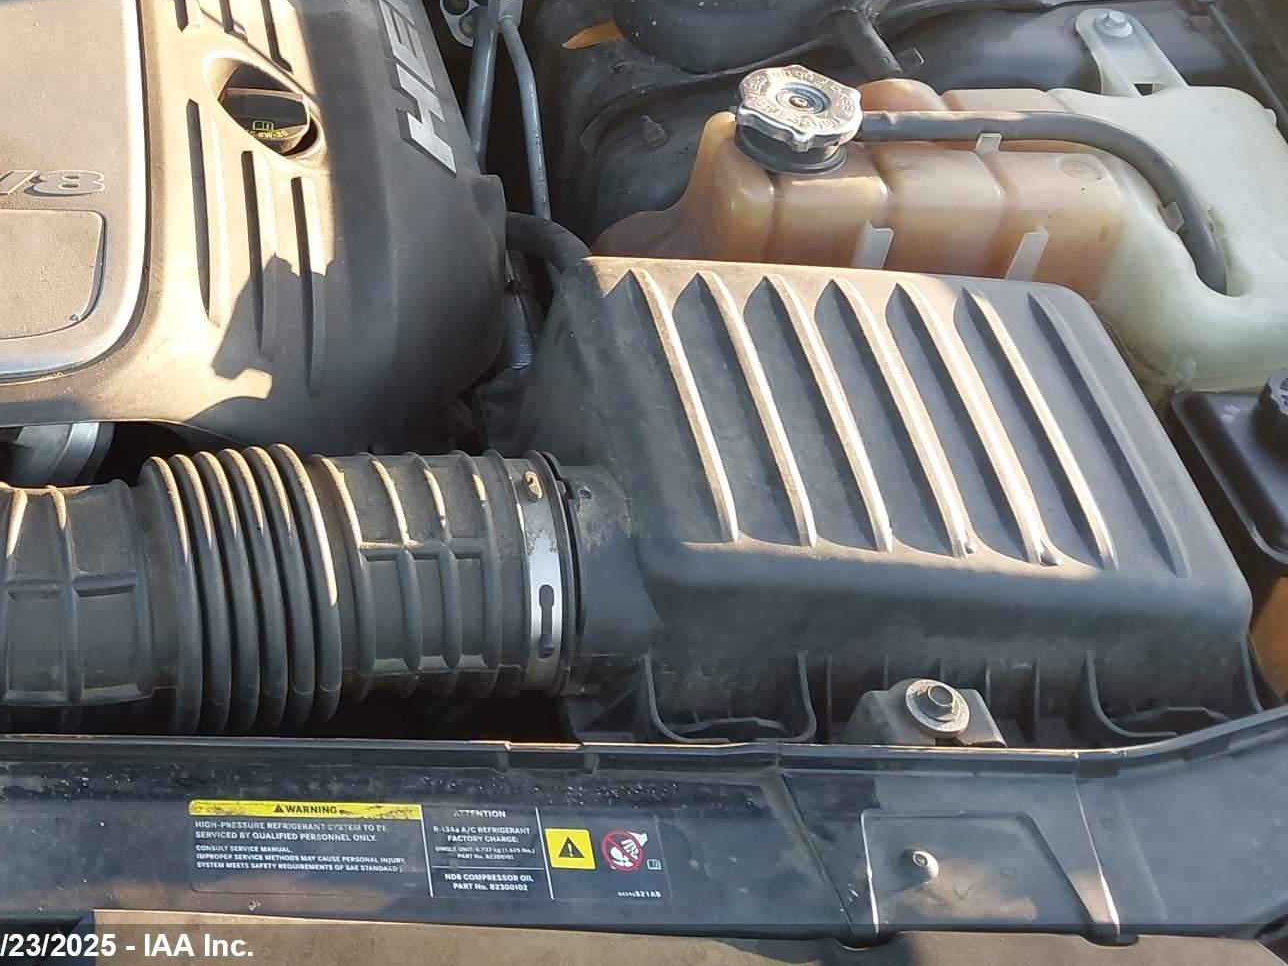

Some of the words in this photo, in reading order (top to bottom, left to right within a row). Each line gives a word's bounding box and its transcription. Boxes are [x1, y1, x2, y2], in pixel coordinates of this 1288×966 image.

[285, 805, 338, 814] WARNING
[453, 809, 506, 818] ATTENTION
[195, 821, 266, 830] HIGH-PRESSURE
[266, 822, 326, 831] REFRIGERANT
[364, 824, 374, 832] TO
[433, 826, 460, 834] R-134a
[461, 826, 477, 834] A/C
[478, 826, 530, 835] REFRIGERANT
[195, 831, 238, 839] SERVICED
[239, 832, 251, 840] BY
[252, 832, 298, 840] QUALIFIED
[300, 833, 351, 841] PERSONNEL
[353, 834, 378, 842] ONLY.
[196, 845, 228, 853] CONSULT
[230, 845, 258, 853] SERVICE
[234, 854, 264, 862] SERVICE
[265, 854, 300, 862] METHODS
[318, 855, 340, 863] CAUSE
[196, 861, 224, 869] SYSTEM
[250, 862, 277, 870] SAFETY
[278, 863, 334, 871] REQUIREMENTS
[463, 874, 518, 882] COMPRESSOR
[520, 874, 535, 882] OIL
[490, 883, 529, 892] 82300102
